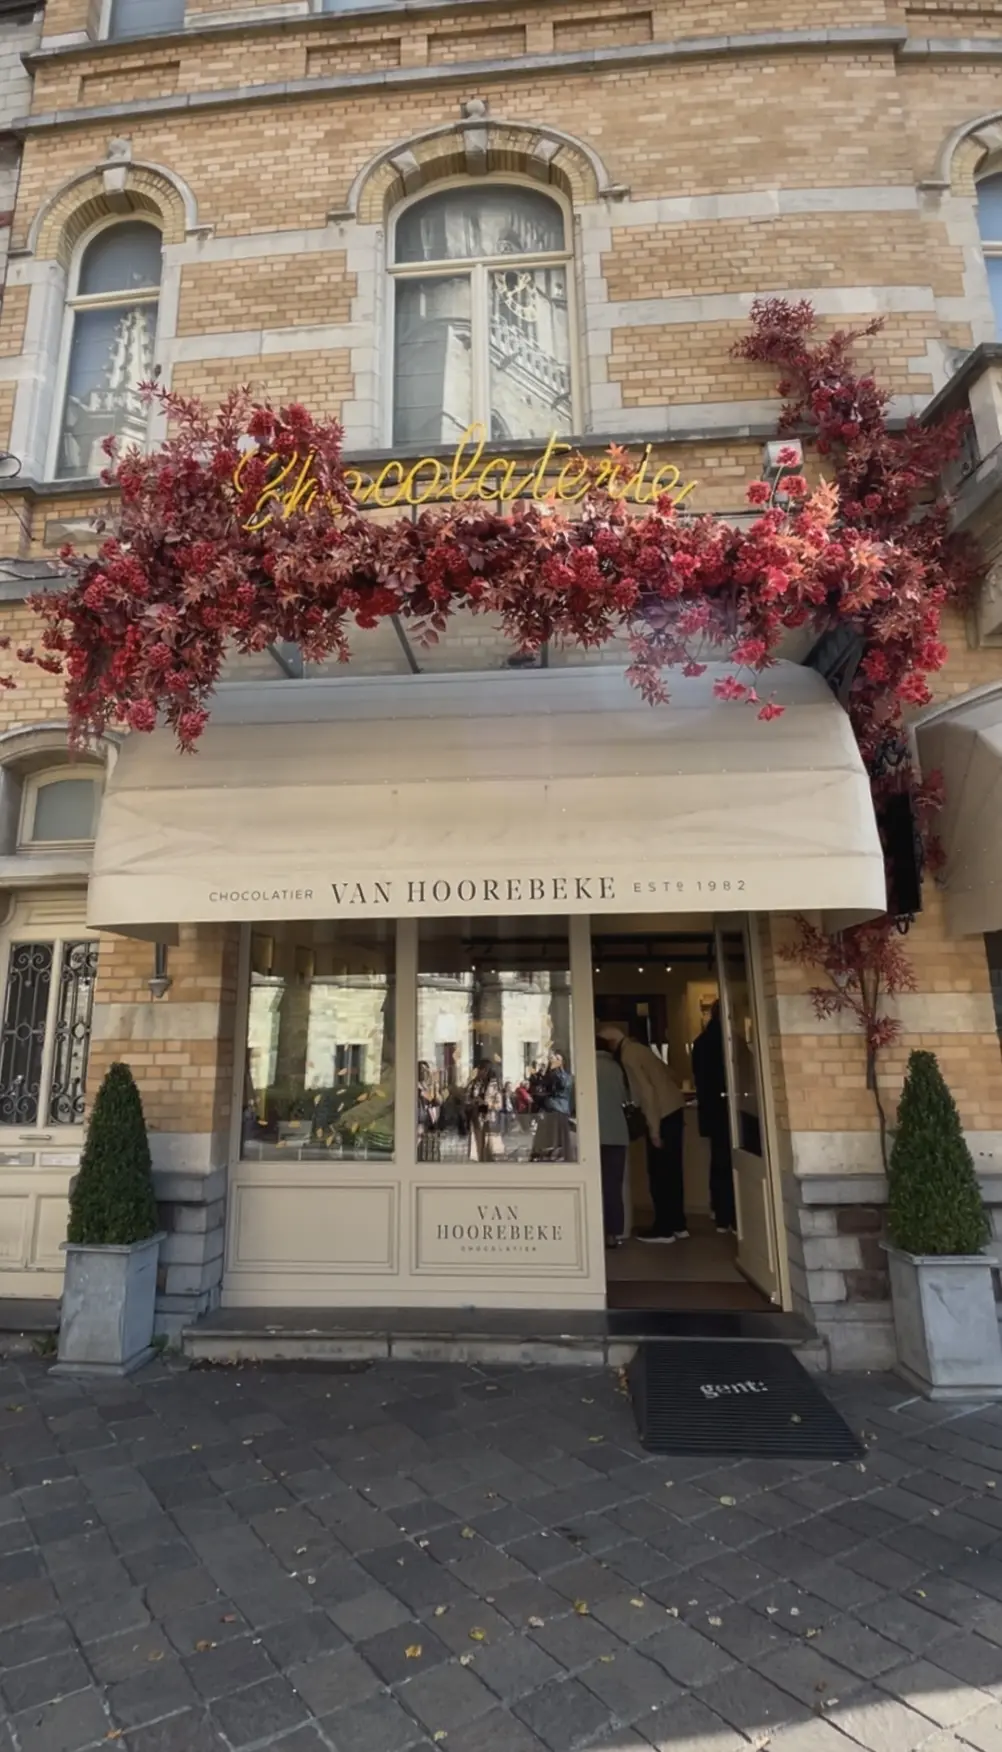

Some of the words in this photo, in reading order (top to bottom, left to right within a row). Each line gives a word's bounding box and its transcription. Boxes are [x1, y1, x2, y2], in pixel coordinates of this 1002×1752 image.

[209, 889, 314, 902] CHOCOLATIER
[331, 881, 392, 904] VAN
[407, 877, 616, 903] HOOREBEKE
[697, 880, 746, 891] 1982
[477, 1205, 518, 1220] VAN
[437, 1225, 562, 1240] HOOREBEKE
